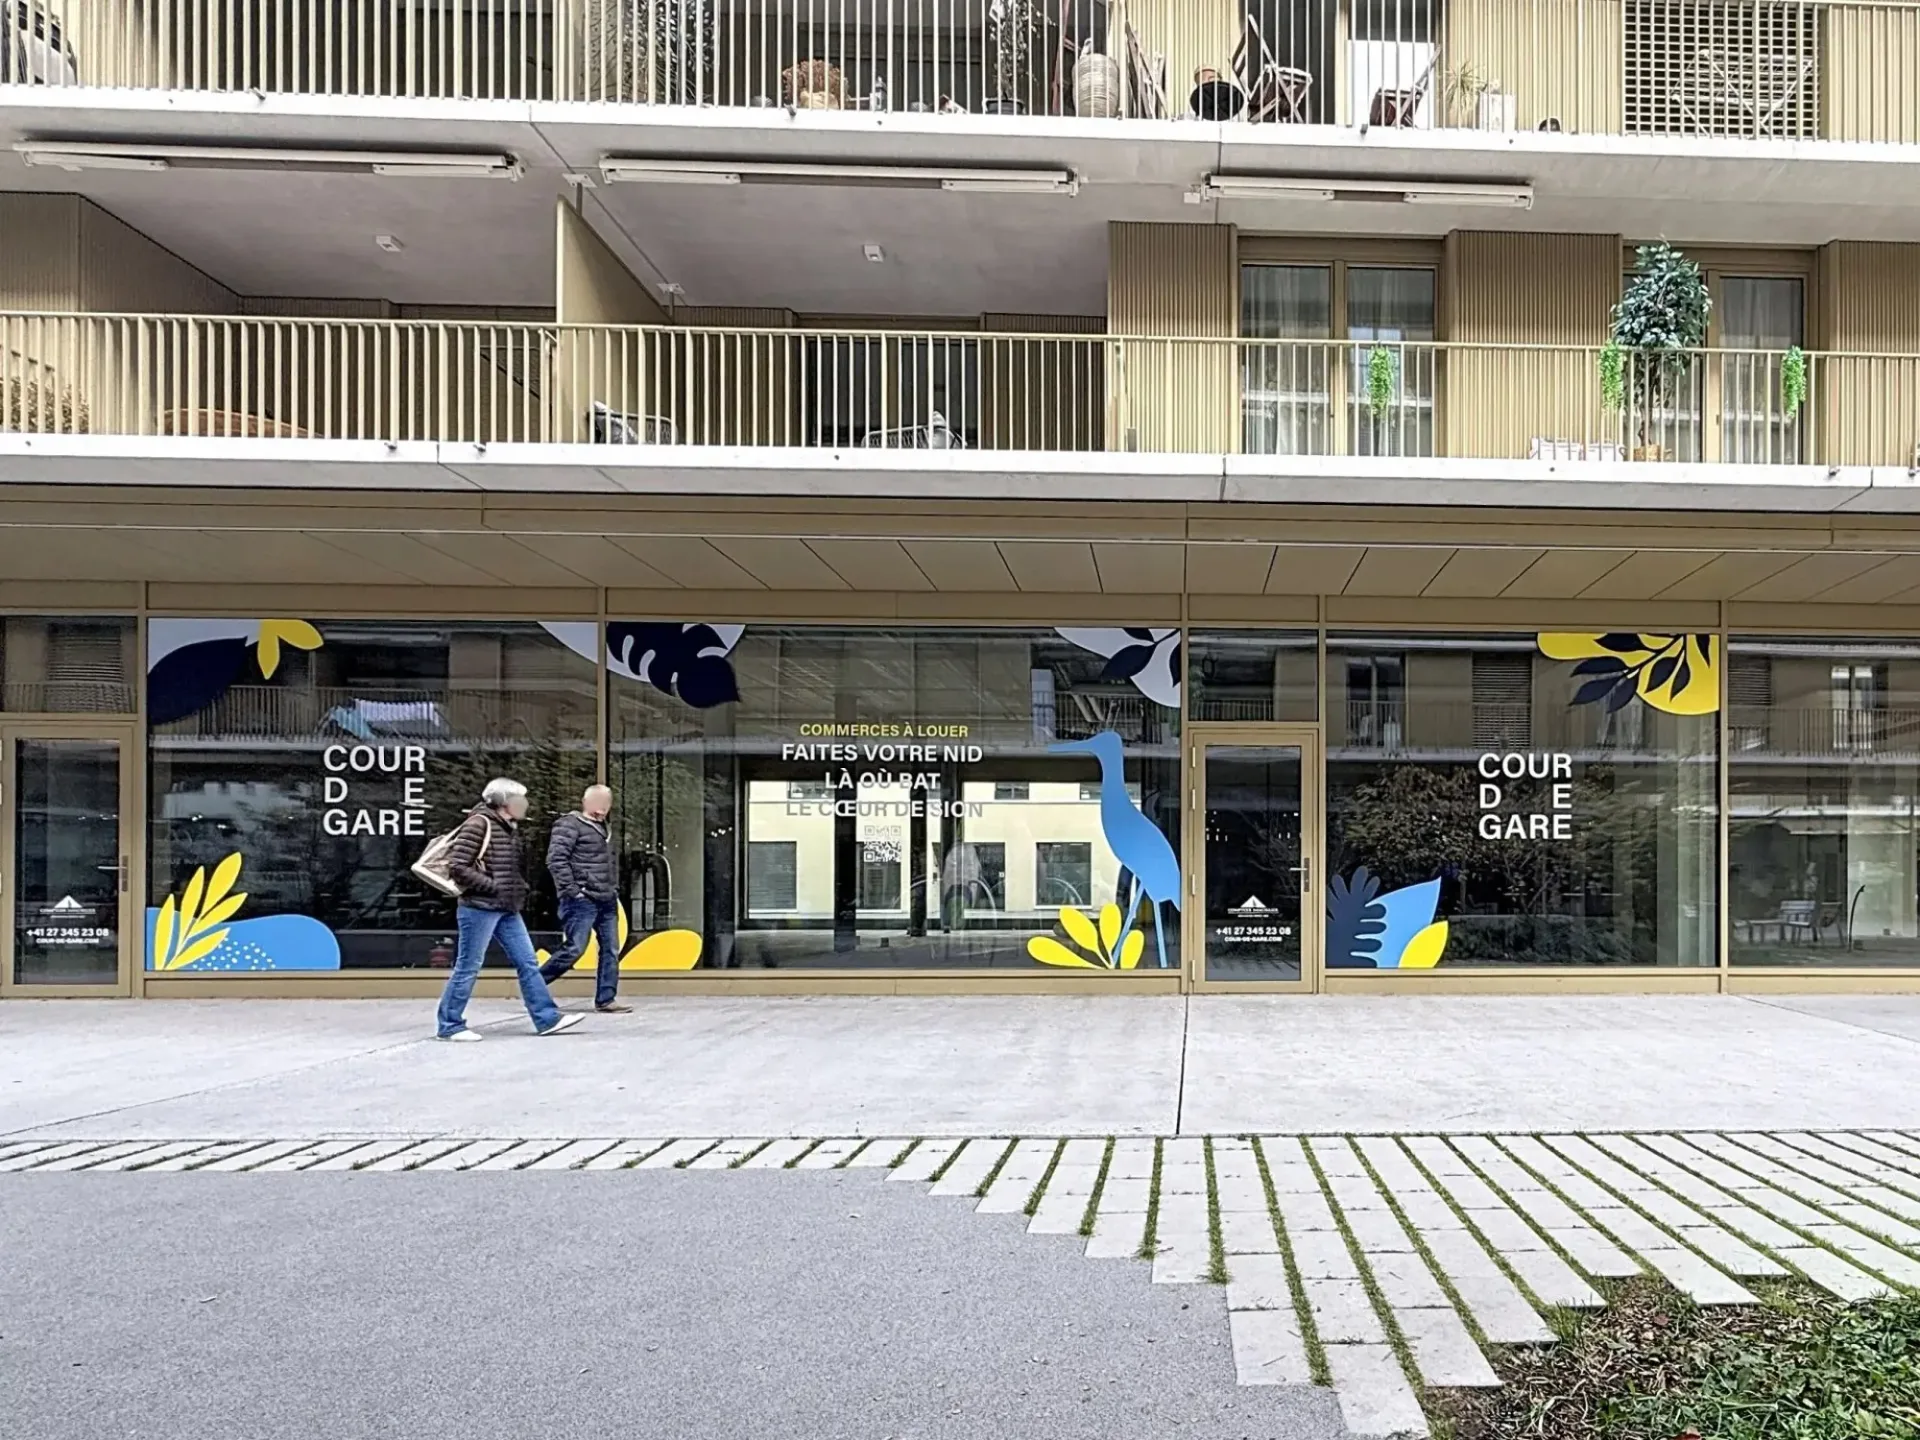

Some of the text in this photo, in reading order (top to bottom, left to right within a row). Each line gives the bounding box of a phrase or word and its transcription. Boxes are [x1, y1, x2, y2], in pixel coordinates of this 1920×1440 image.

[800, 722, 968, 738] COMMERCES À LOUER
[323, 745, 426, 772] COUR
[782, 743, 983, 762] FAITES VOTRE NID
[1478, 752, 1572, 778] COUR
[825, 768, 941, 790] LÀ OÙ BAT
[786, 800, 983, 818] LE CŒUR DE SION
[323, 808, 425, 836] GARE
[1478, 814, 1573, 840] GARE
[26, 928, 109, 937] +41 27 345 23 08
[1215, 926, 1292, 935] +41 27 345 23 08
